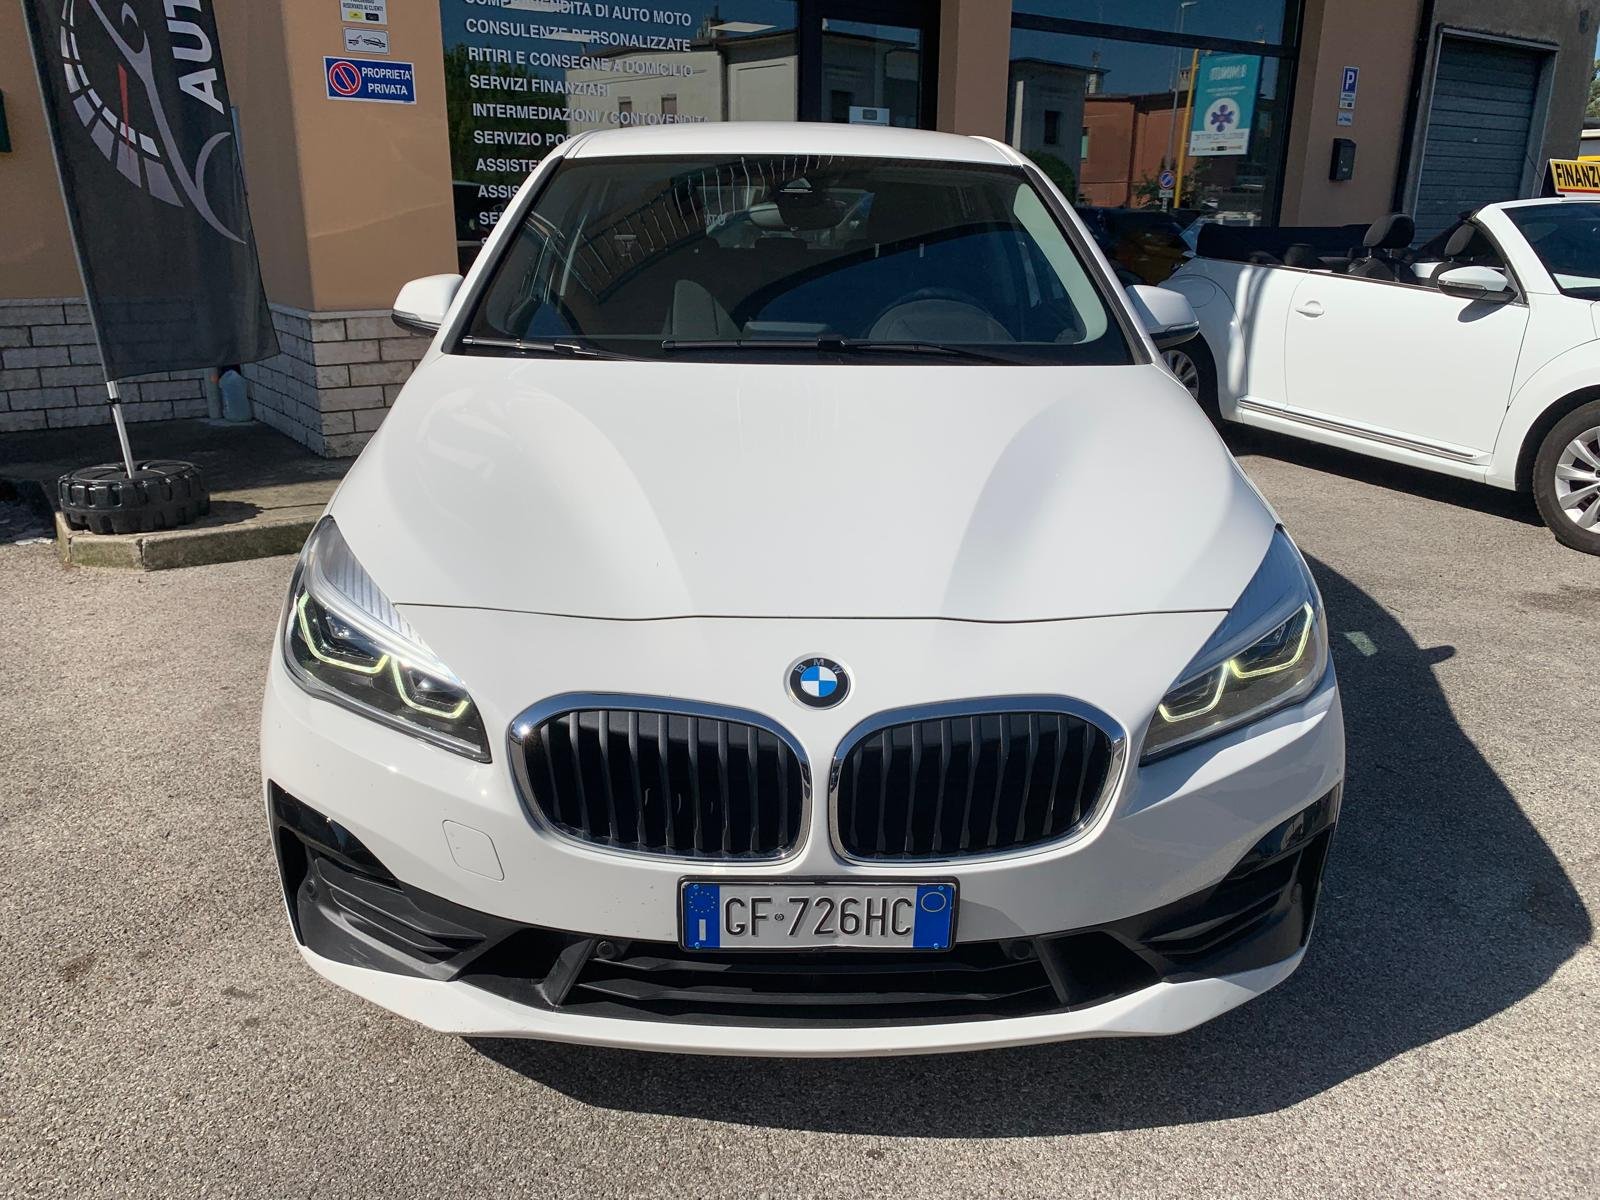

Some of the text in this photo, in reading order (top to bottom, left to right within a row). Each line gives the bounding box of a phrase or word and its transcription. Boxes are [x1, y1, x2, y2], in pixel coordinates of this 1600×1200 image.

[595, 4, 609, 18] DI
[612, 6, 650, 22] AUTO
[653, 10, 692, 26] MOTO
[468, 47, 694, 77] RITIRI E CONSEGNE A DOMICILIO
[361, 67, 412, 80] PROPRIETA'
[1345, 71, 1355, 90] P
[367, 83, 408, 95] PRIVATA
[469, 75, 610, 97] SERVIZI FINANZIARI
[472, 103, 600, 123] INTERMEDIAZIONI
[473, 130, 541, 146] SERVIZIO
[476, 158, 542, 172] ASSISTE
[479, 211, 504, 225] SE
[795, 658, 844, 675] BMW
[725, 897, 772, 937] GF
[787, 897, 913, 937] 726HC
